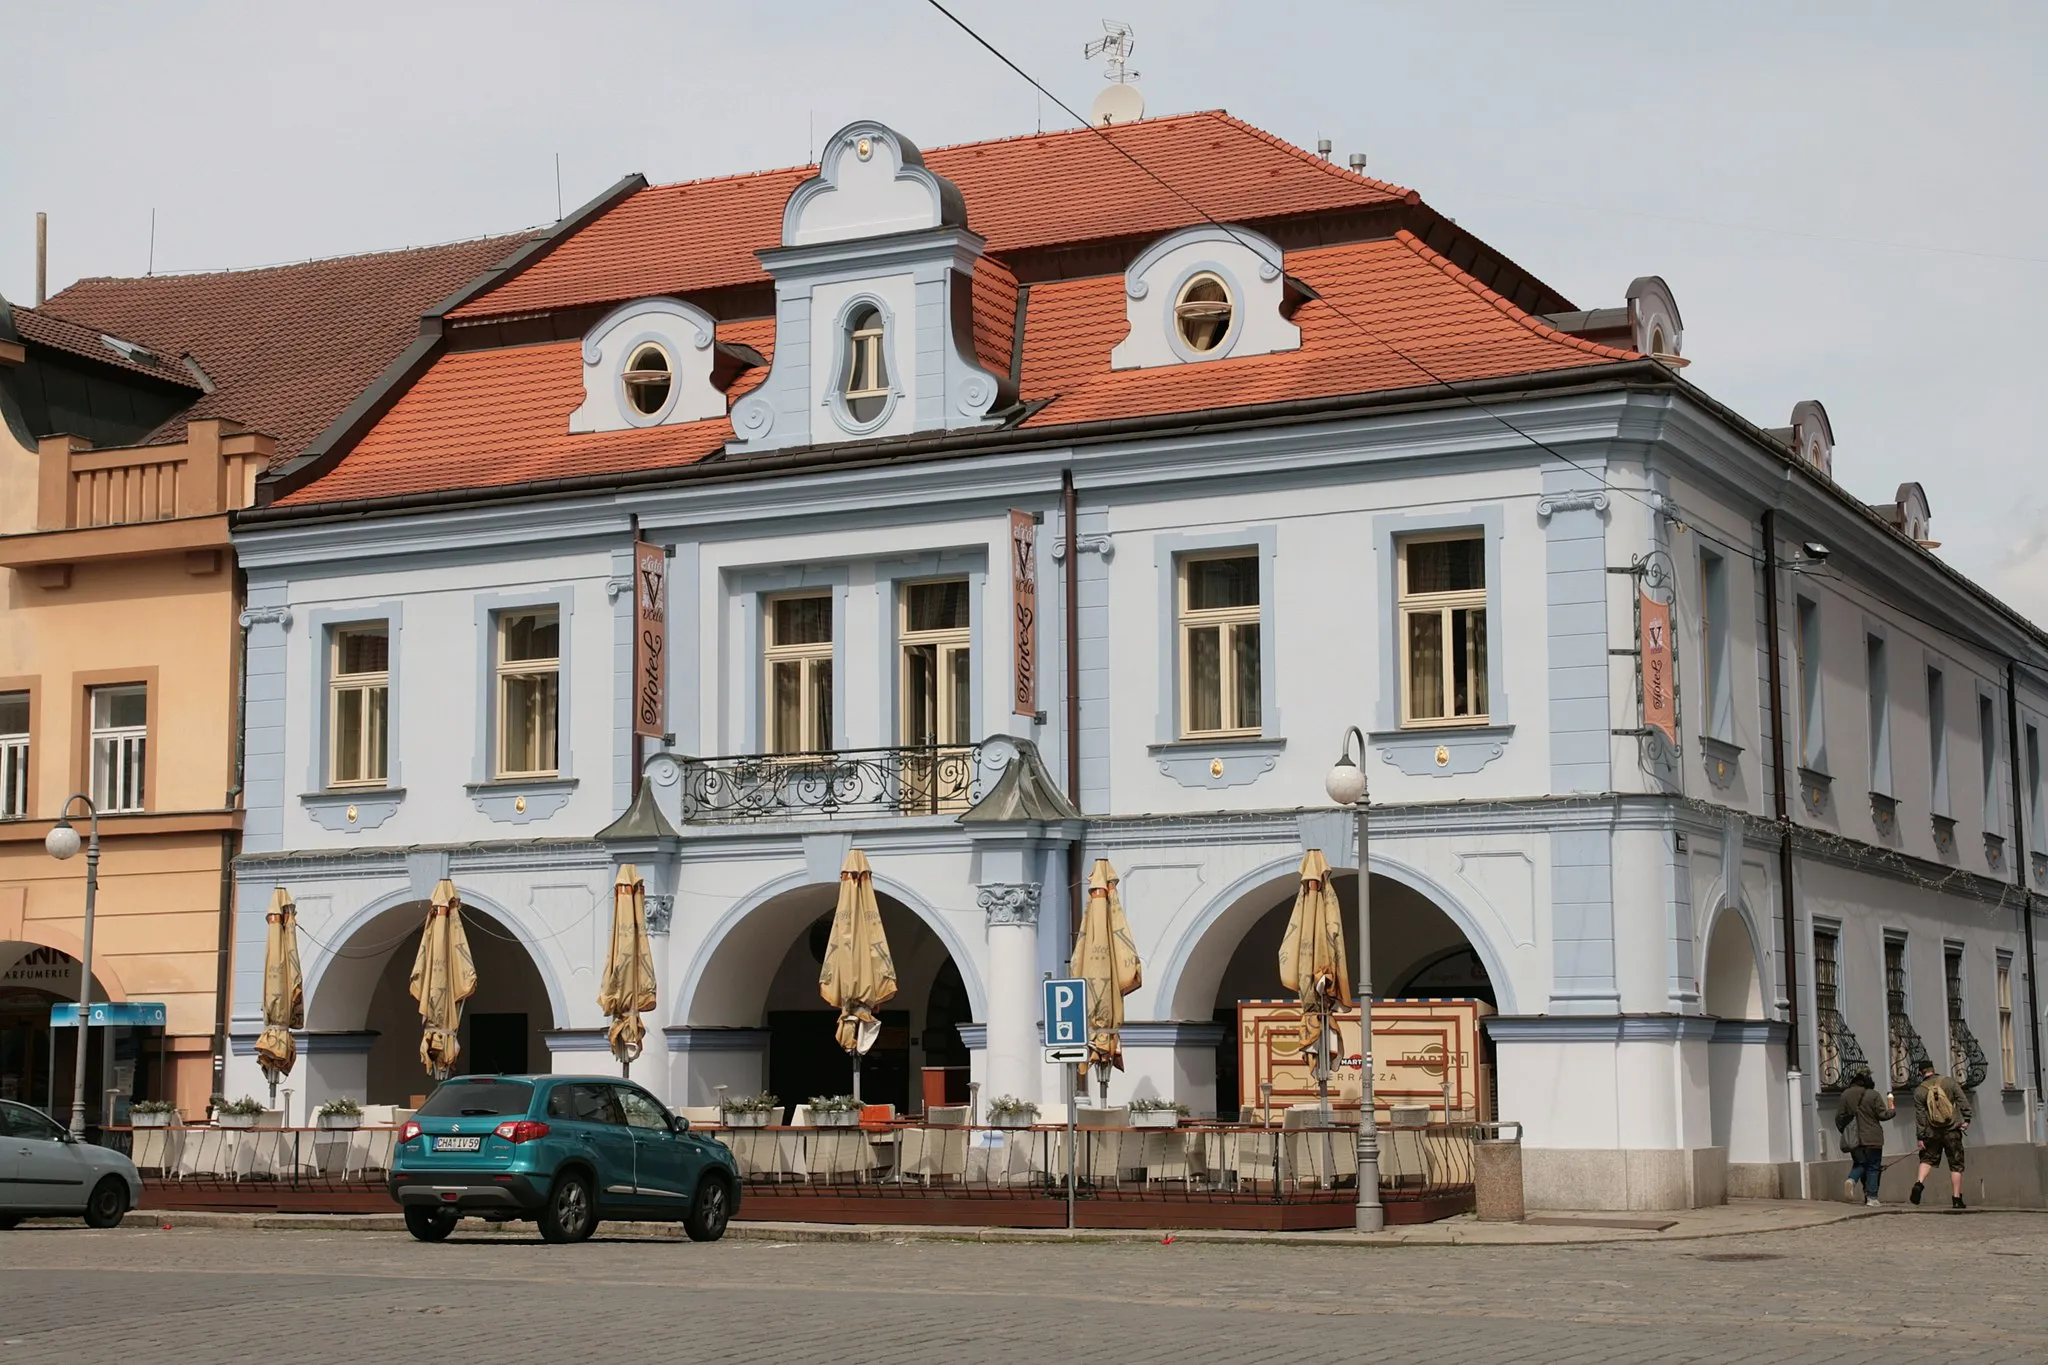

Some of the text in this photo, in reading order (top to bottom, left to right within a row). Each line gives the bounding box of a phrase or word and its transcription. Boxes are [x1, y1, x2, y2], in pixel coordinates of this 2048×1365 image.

[1017, 602, 1033, 703] Hotel
[641, 630, 662, 725] Hotel
[4, 969, 70, 979] ARFUMERIE
[1055, 986, 1074, 1022] P
[1244, 1025, 1300, 1039] MART
[437, 1138, 480, 1148] CHA IV 59
